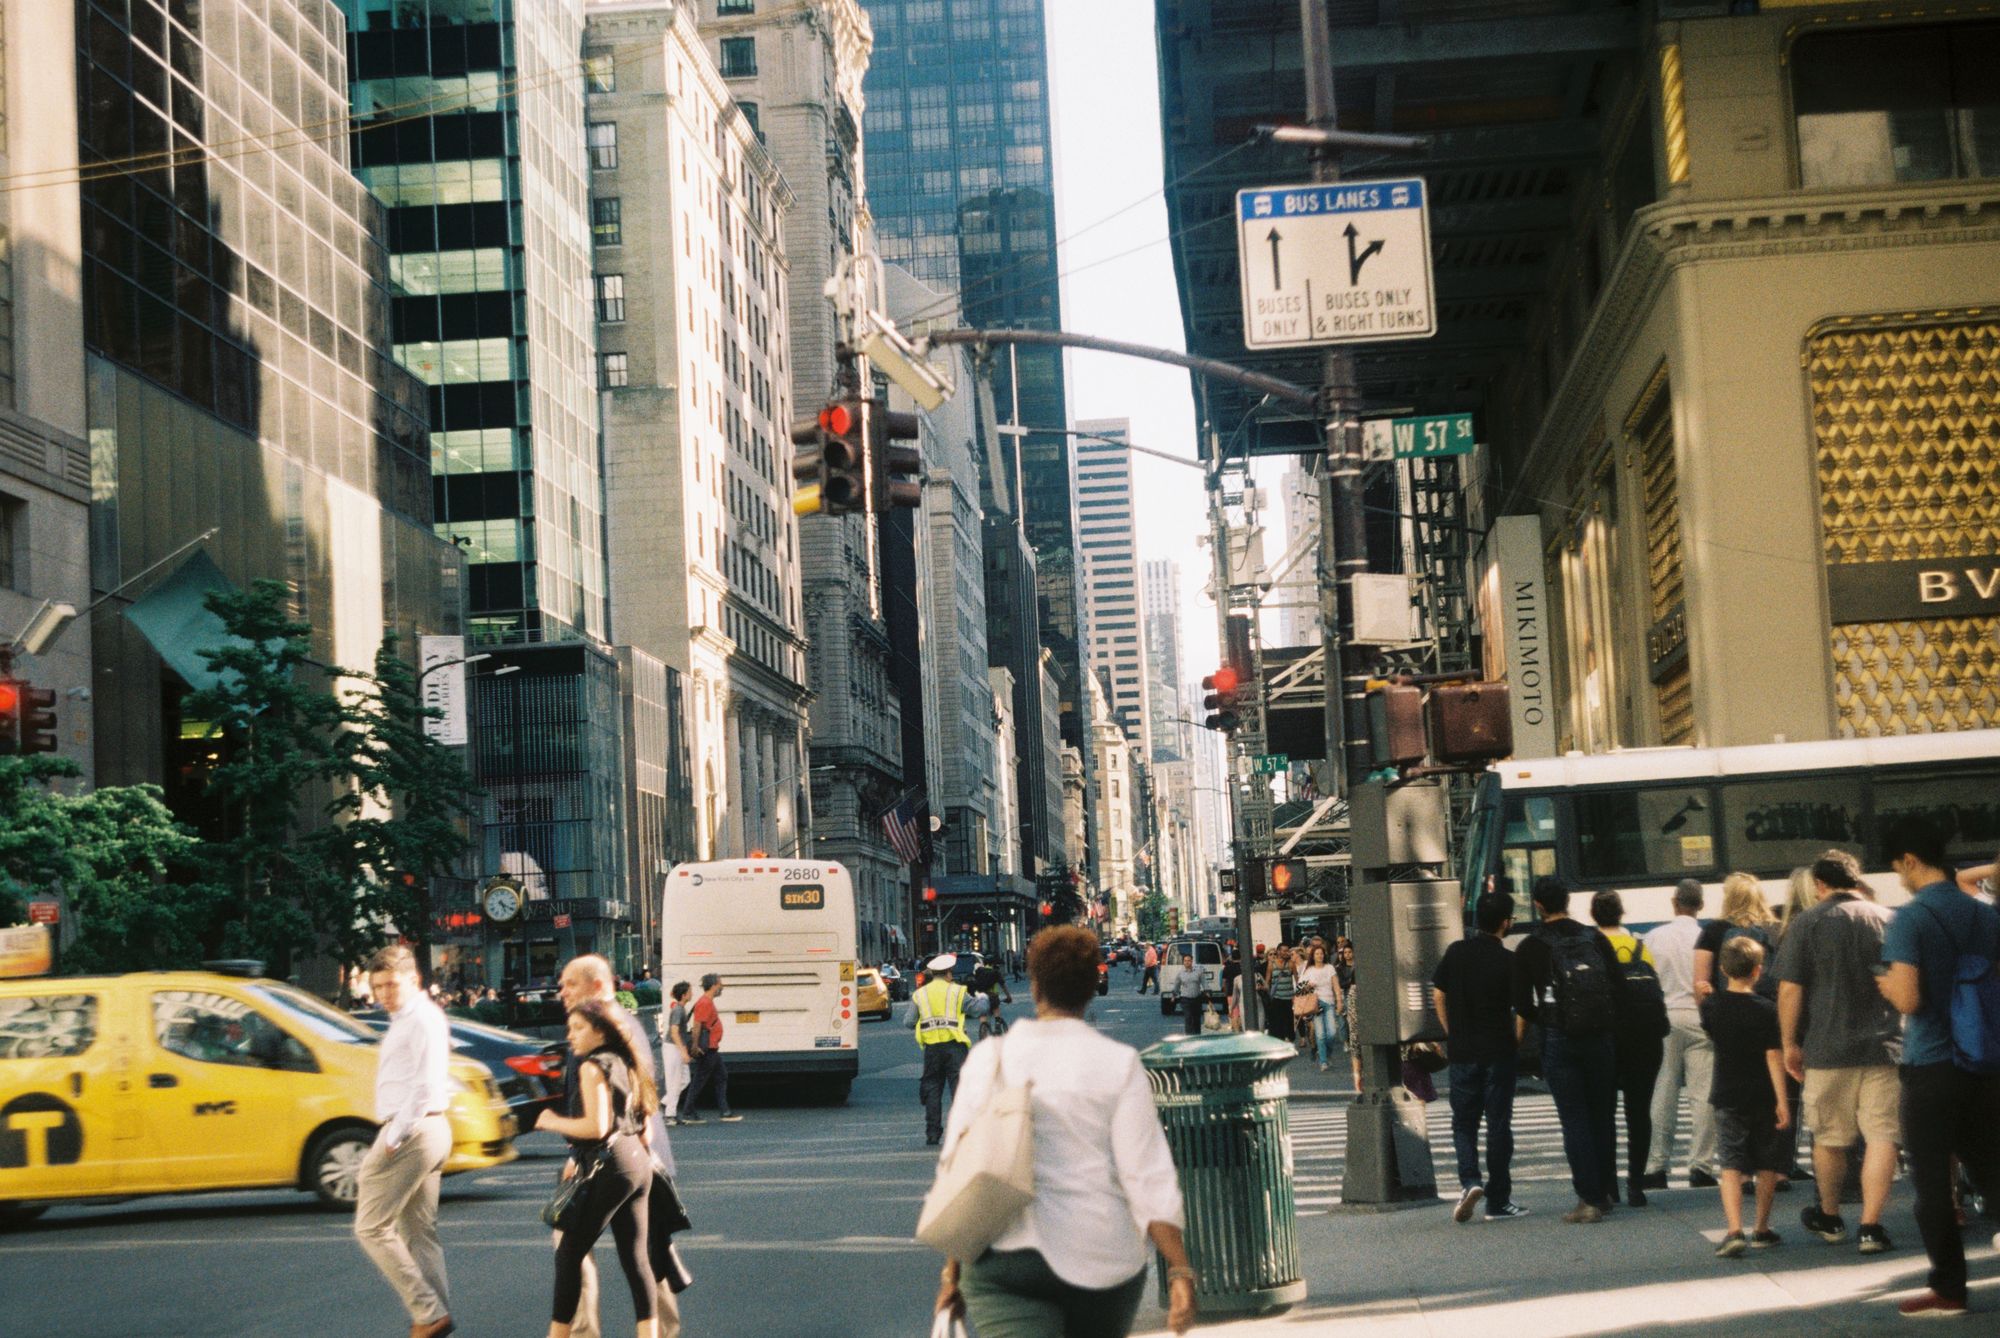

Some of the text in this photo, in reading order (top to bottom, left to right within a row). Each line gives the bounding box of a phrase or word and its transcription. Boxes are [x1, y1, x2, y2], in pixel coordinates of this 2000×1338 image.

[1285, 190, 1381, 213] BUS LANES
[1257, 296, 1301, 314] BUSES
[1326, 288, 1411, 310] BUSES ONLY
[1263, 319, 1298, 336] ONLY
[1316, 310, 1424, 333] & RIGHT TURNS
[1394, 423, 1415, 452] W
[1424, 421, 1448, 451] 57
[1515, 581, 1544, 725] MIKIMOTO
[1253, 758, 1263, 771] W
[1267, 757, 1277, 770] 57
[784, 868, 820, 880] 2680
[1170, 1093, 1201, 1102] Avenue
[8, 1110, 65, 1167] T
